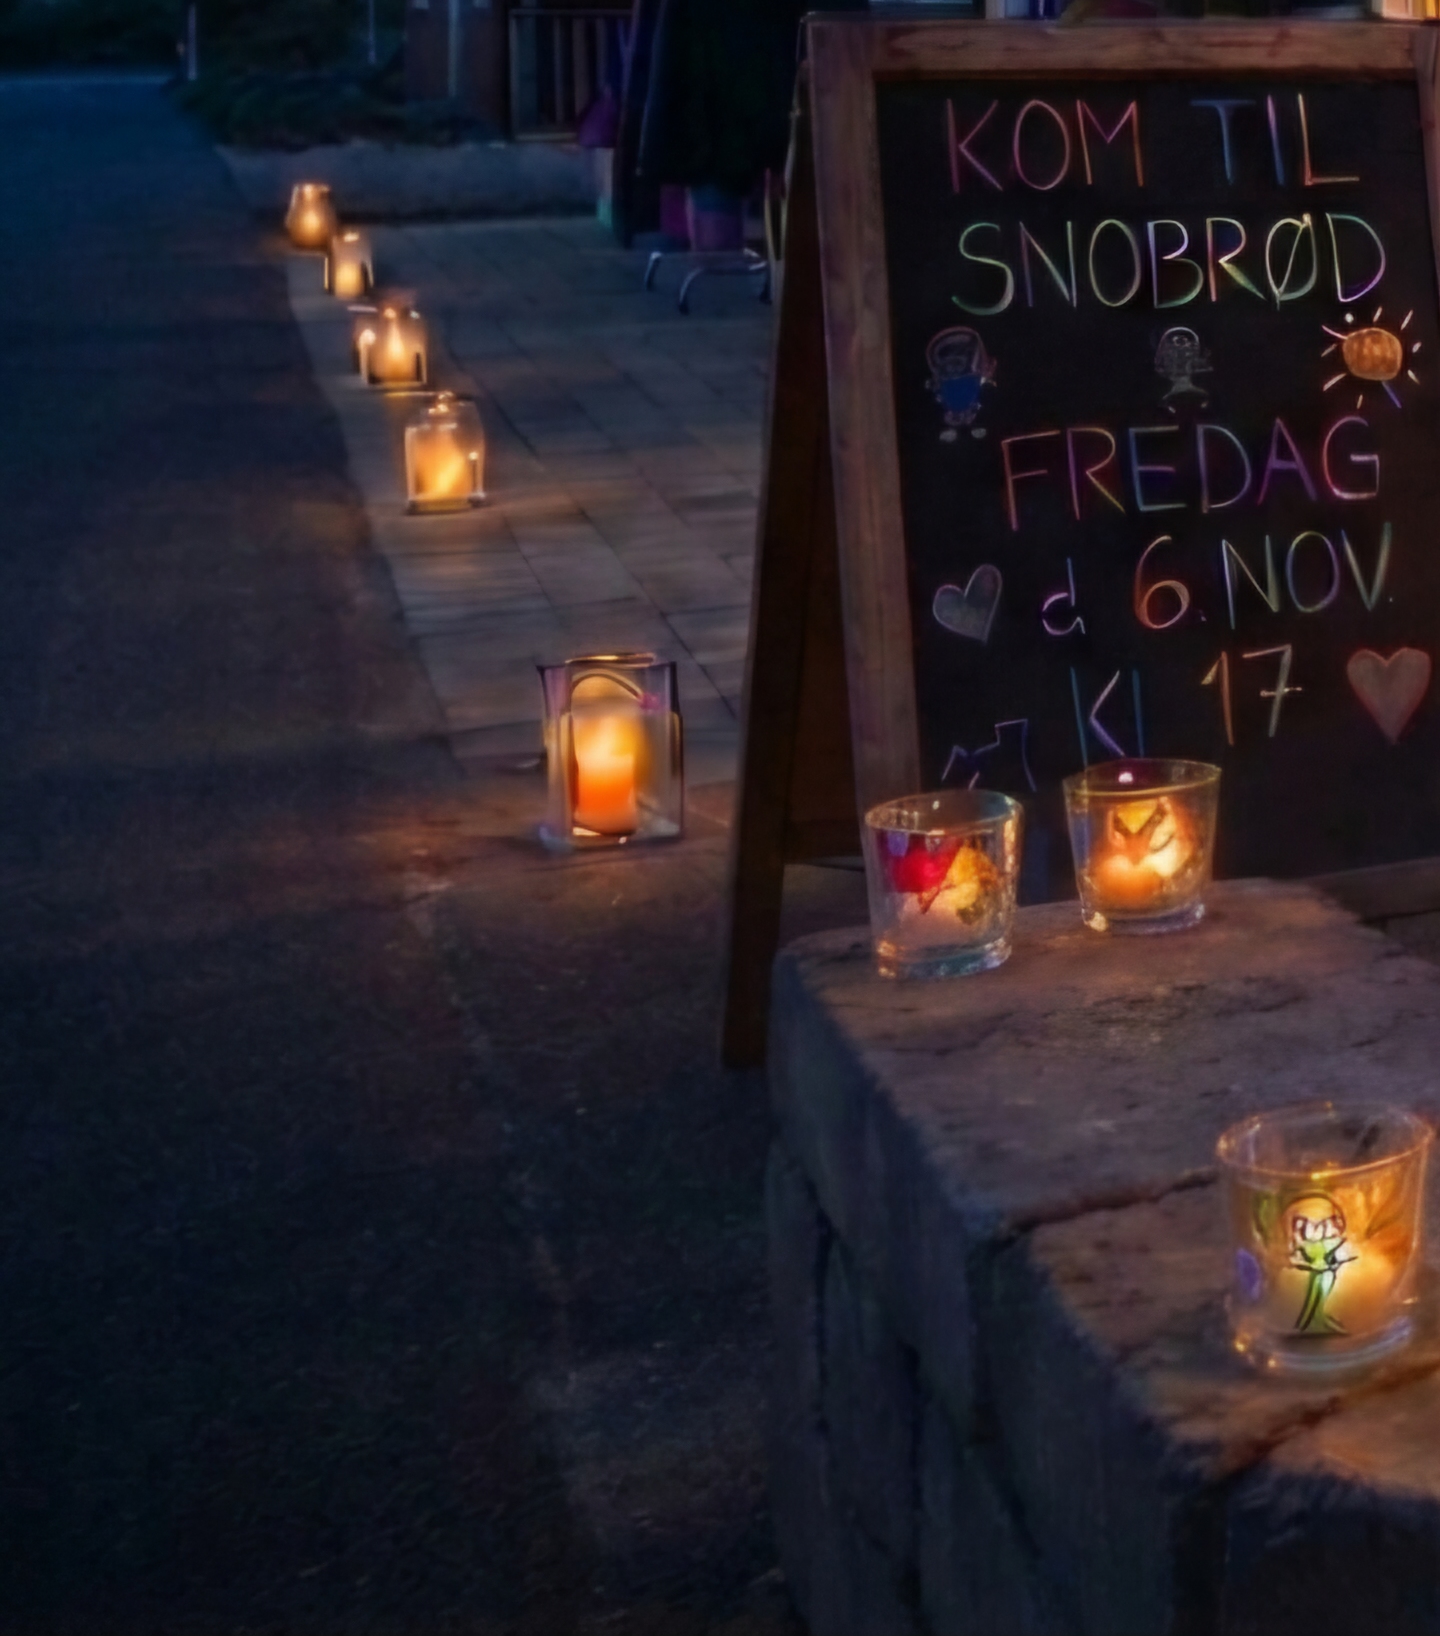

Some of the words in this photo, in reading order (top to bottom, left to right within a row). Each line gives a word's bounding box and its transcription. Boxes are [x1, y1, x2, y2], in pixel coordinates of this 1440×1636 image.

[946, 97, 1144, 195] KOM
[1190, 92, 1360, 187] TIL
[951, 210, 1387, 316] SNOBRØD
[1001, 415, 1381, 532] FREDAG
[1200, 643, 1304, 747] 17
